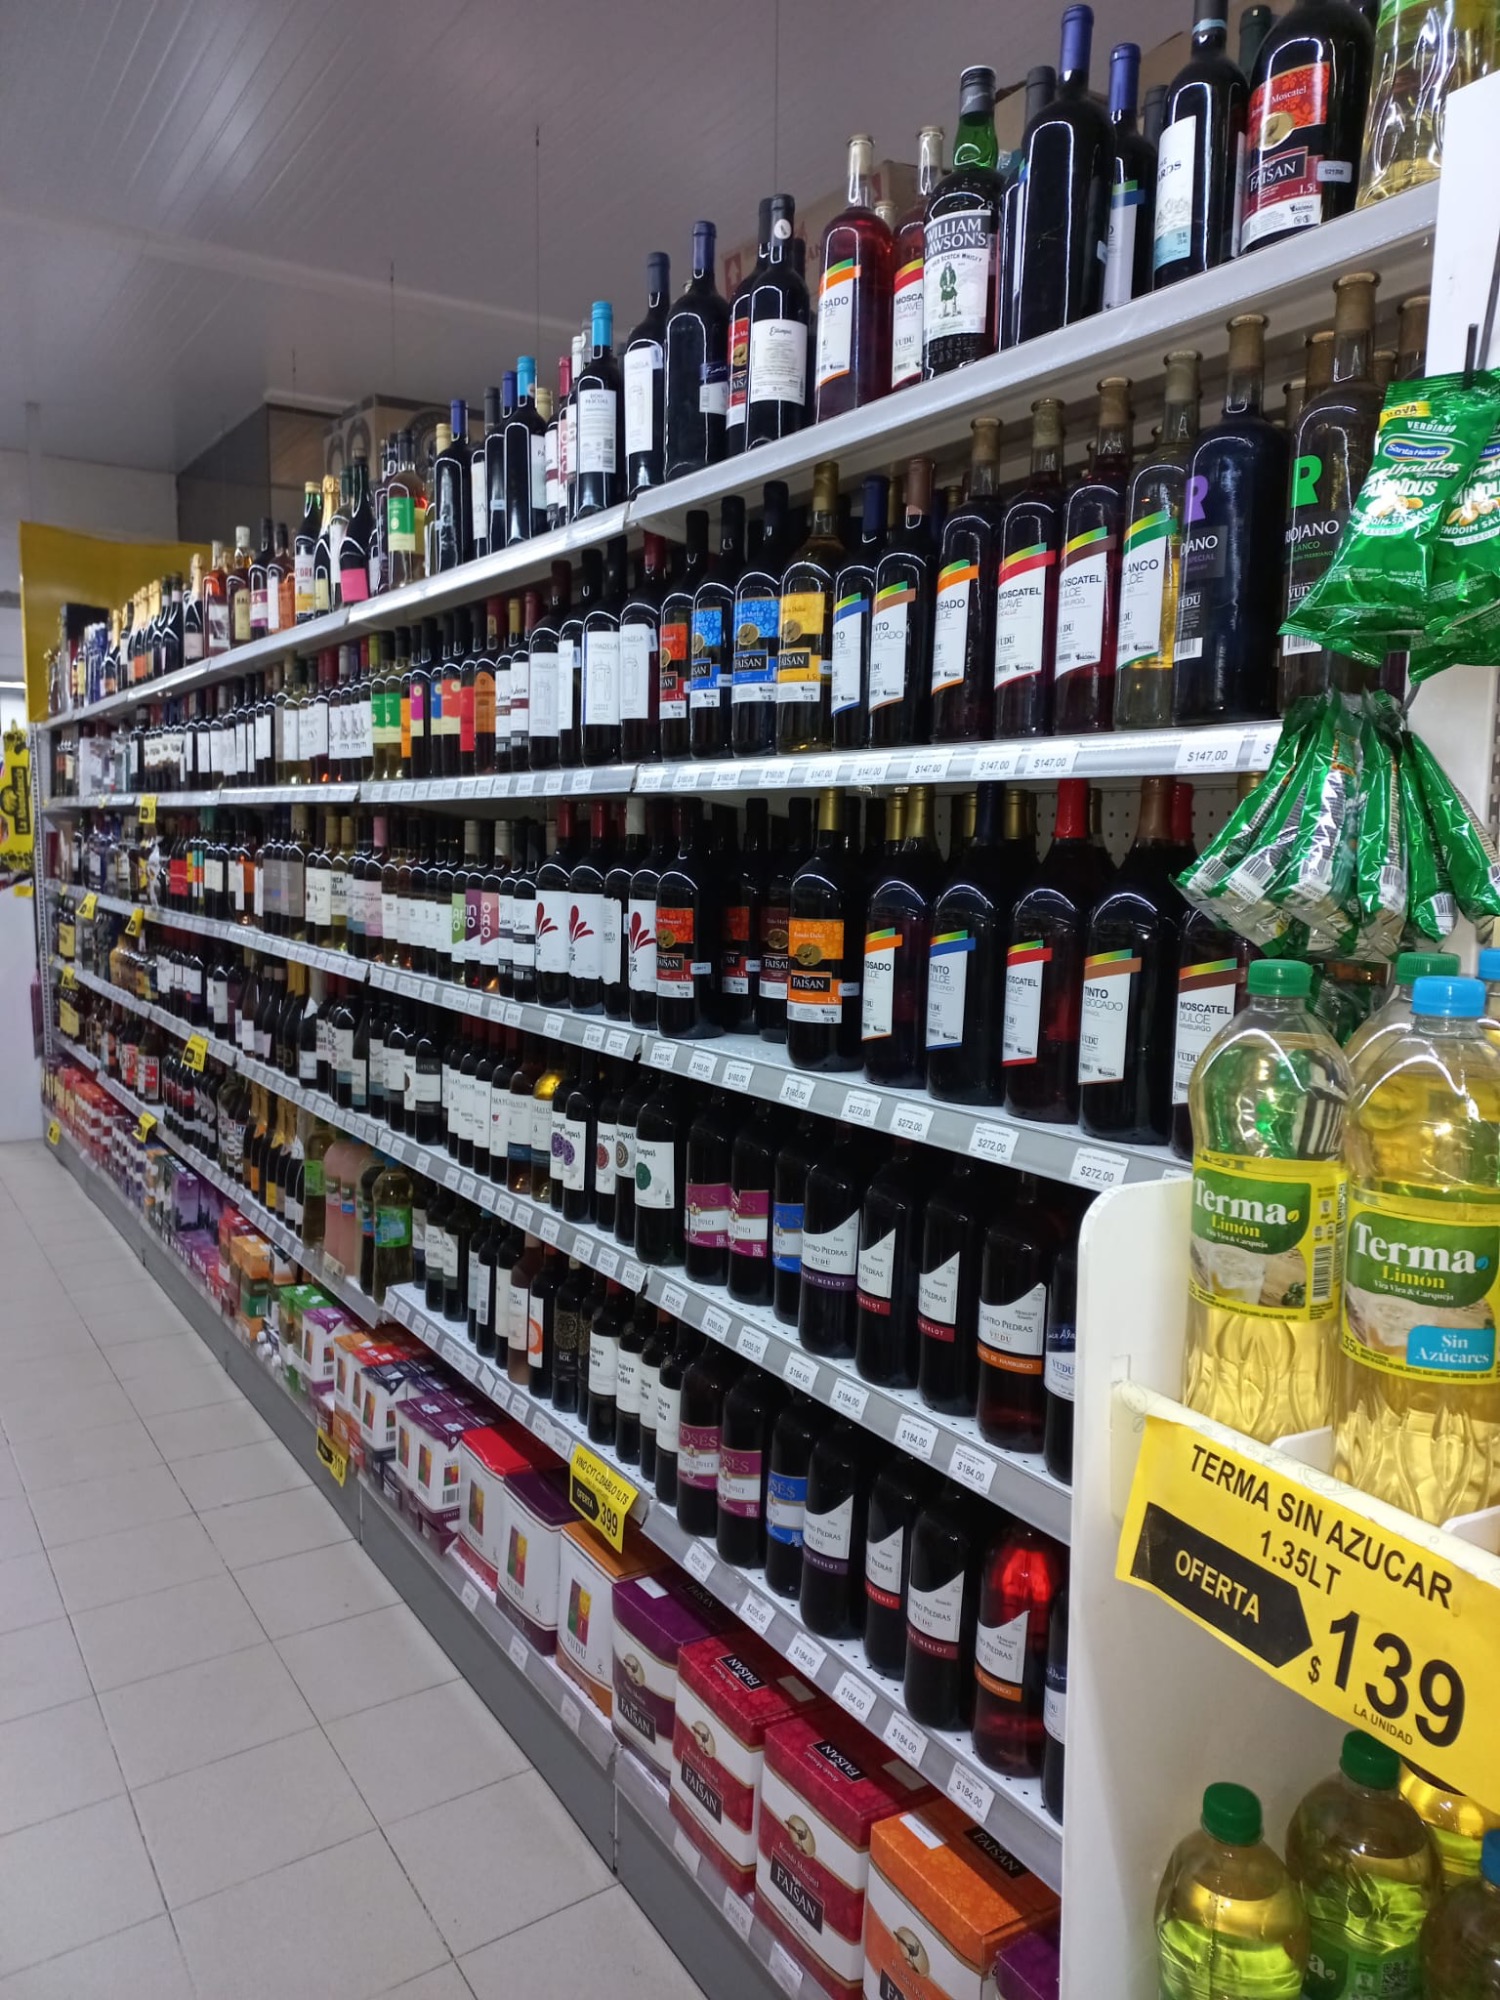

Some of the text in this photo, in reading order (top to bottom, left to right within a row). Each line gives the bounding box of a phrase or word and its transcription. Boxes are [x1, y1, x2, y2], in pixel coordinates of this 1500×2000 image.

[1271, 86, 1307, 104] Moscatel
[1250, 161, 1297, 192] FAISAN
[926, 218, 982, 242] WILLIAM
[895, 292, 924, 306] MOSCA
[1291, 454, 1323, 509] R
[1184, 475, 1209, 525] R
[1441, 524, 1479, 535] ENDOIM
[1291, 540, 1321, 553] LANCO
[998, 586, 1042, 600] MOSCATEL
[915, 764, 942, 774] $147.00
[979, 760, 1010, 771] $147.00
[1033, 757, 1067, 769] $147.00
[792, 977, 825, 990] FAISAN
[1085, 986, 1109, 999] TINTO
[1179, 1001, 1232, 1016] MOSCATEL
[1178, 1012, 1211, 1026] DULCE
[848, 1105, 871, 1118] $272.00
[898, 1117, 923, 1132] $272.00
[977, 1138, 1007, 1153] $272.00
[1080, 1165, 1115, 1183] $272.00
[1193, 1175, 1288, 1226] Terma
[1211, 1213, 1261, 1239] Limón
[821, 1245, 848, 1258] PIEDRAS
[1353, 1220, 1478, 1274] Terma
[811, 1255, 831, 1267] VUDU
[862, 1263, 884, 1278] PIEDRAS
[1382, 1265, 1446, 1290] Limón
[924, 1289, 947, 1304] PIEDRAS
[1389, 1283, 1406, 1295] Vira
[1415, 1288, 1455, 1301] Carqueja
[989, 1330, 1013, 1344] VUDU
[1001, 1320, 1034, 1334] PIEDRAS
[1442, 1333, 1469, 1350] Sin
[1415, 1346, 1490, 1366] Azúcares
[1052, 1358, 1076, 1376] VUDU
[837, 1390, 860, 1408] $184.00
[901, 1429, 928, 1449] $184.00
[576, 1454, 588, 1471] VINO
[586, 1464, 596, 1477] CYT
[957, 1460, 985, 1483] $184.00
[576, 1488, 594, 1510] OFERTA
[600, 1502, 618, 1538] 399
[1190, 1444, 1453, 1610] TERMA SIN AZUCAR
[816, 1526, 842, 1541] PIEDRAS
[1259, 1530, 1342, 1596] 1.35LT
[1174, 1549, 1261, 1625] OFERTA
[746, 1603, 766, 1624] $205.00
[923, 1605, 951, 1622] PIEDRAS
[566, 1635, 588, 1660] VUDU
[790, 1646, 816, 1667] $184.00
[985, 1642, 1014, 1661] PIEDRAS
[726, 1657, 761, 1688] FAISAN
[1307, 1610, 1466, 1748] $ 139
[840, 1686, 865, 1711] $184.00
[620, 1699, 651, 1735] FAISAN
[1353, 1703, 1414, 1746] LA UNIDAD
[891, 1728, 918, 1754] $184.00
[821, 1744, 861, 1780] FAISAN
[684, 1765, 718, 1812] FAISAN
[955, 1780, 984, 1809] $184.00
[974, 1831, 1020, 1873] FAISAN
[776, 1868, 817, 1919] FAISAN
